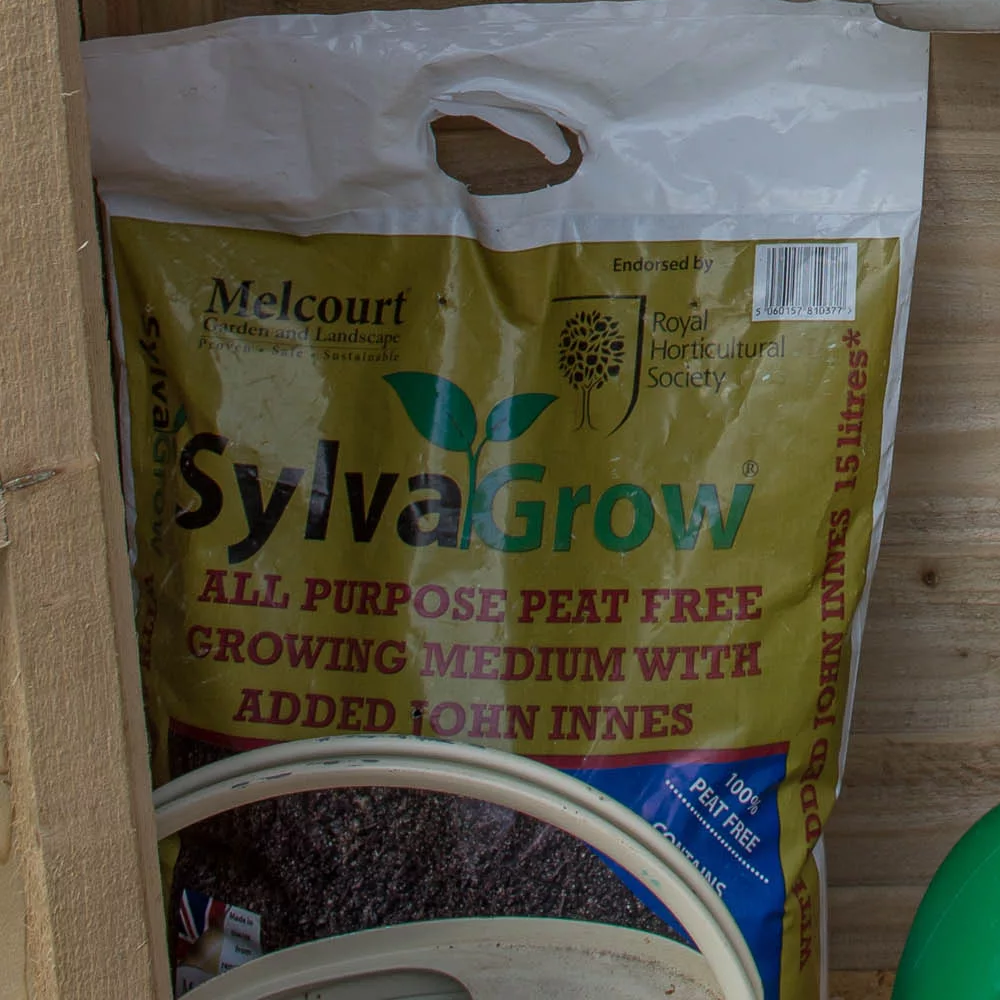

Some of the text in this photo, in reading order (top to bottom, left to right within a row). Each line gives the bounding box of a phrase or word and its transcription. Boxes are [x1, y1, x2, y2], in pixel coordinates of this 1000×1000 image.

[613, 256, 714, 275] Endorsed by
[206, 277, 407, 327] Melcourt
[766, 306, 802, 317] 060157
[806, 305, 842, 316] 810377
[203, 317, 401, 349] Garden and Landscape
[652, 310, 708, 338] Royal
[198, 337, 400, 364] Proven Safe Sustainable
[650, 335, 786, 361] Horticultural
[647, 366, 726, 394] Society
[833, 454, 860, 493] 15
[820, 507, 852, 622] INNES
[197, 568, 763, 624] ALL PURPOSE PEAT FREE
[187, 624, 762, 682] GROWING MEDIUM WITH
[813, 628, 843, 731] JOHN
[232, 688, 693, 741] ADDED JOHN INNES
[724, 772, 762, 815] 100%
[688, 776, 761, 854] PEAT FREE
